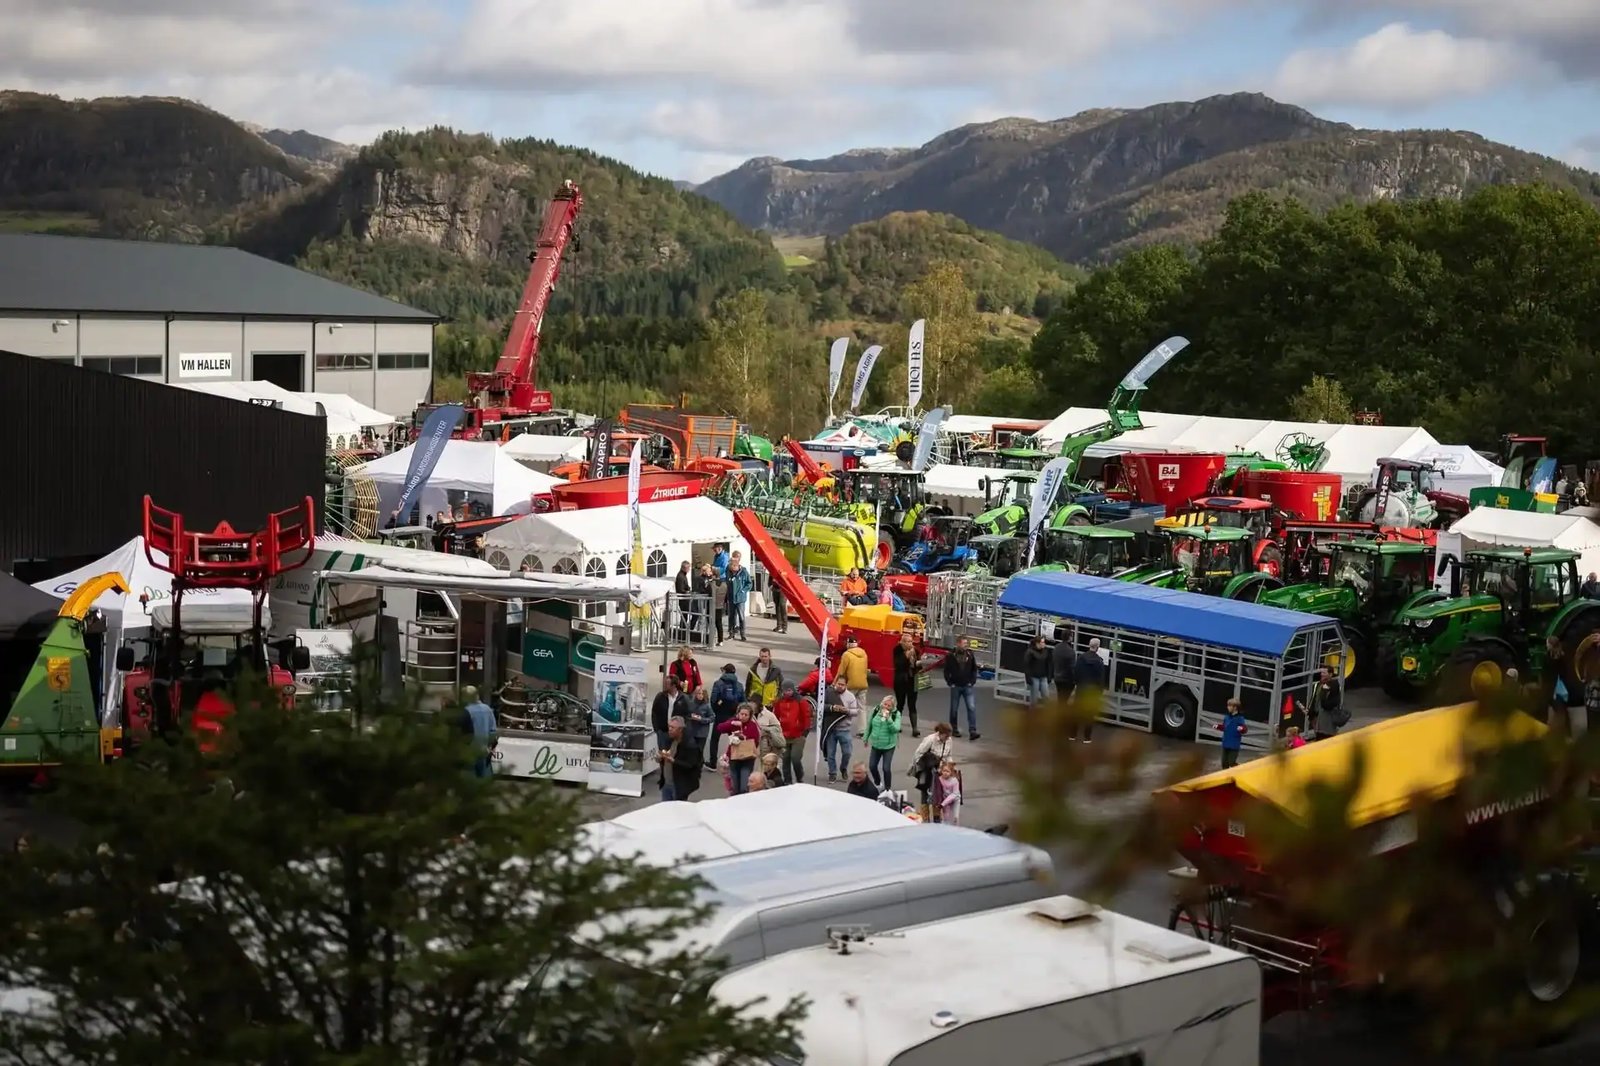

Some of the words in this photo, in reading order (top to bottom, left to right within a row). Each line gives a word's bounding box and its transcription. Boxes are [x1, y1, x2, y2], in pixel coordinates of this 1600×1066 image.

[181, 359, 195, 371] VM
[197, 359, 231, 371] HALLEN
[533, 648, 554, 659] GEA
[599, 662, 626, 676] GEA
